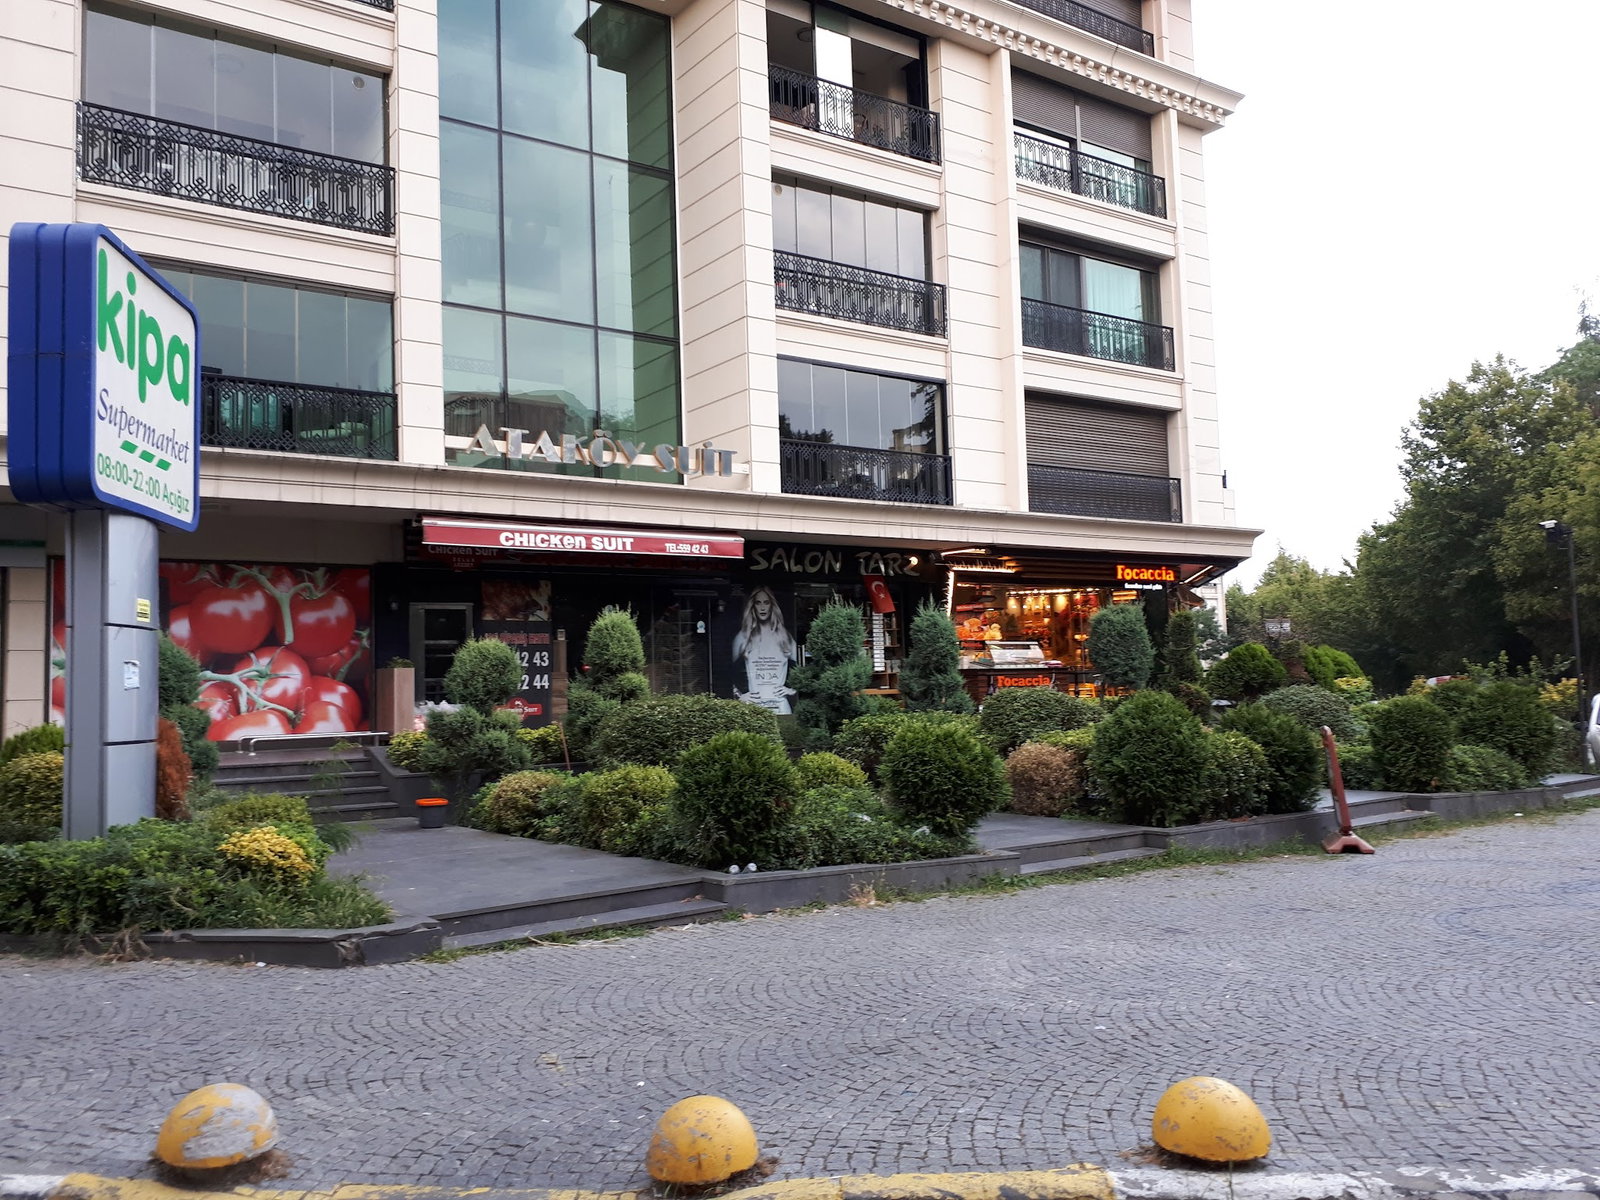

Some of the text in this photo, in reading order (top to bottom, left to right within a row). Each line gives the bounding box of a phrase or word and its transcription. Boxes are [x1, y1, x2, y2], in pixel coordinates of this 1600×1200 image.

[98, 248, 190, 406] kipa
[97, 388, 189, 464] Supermarket
[465, 423, 738, 477] ATAKÖY SUİT
[162, 482, 190, 514] Açığız
[592, 536, 634, 552] SUIT
[691, 544, 700, 553] 42
[700, 545, 709, 554] 43
[749, 547, 842, 574] SALON
[1116, 565, 1175, 581] Focaccia
[533, 651, 549, 666] 43
[533, 674, 549, 690] 44
[997, 675, 1050, 687] Focaccia
